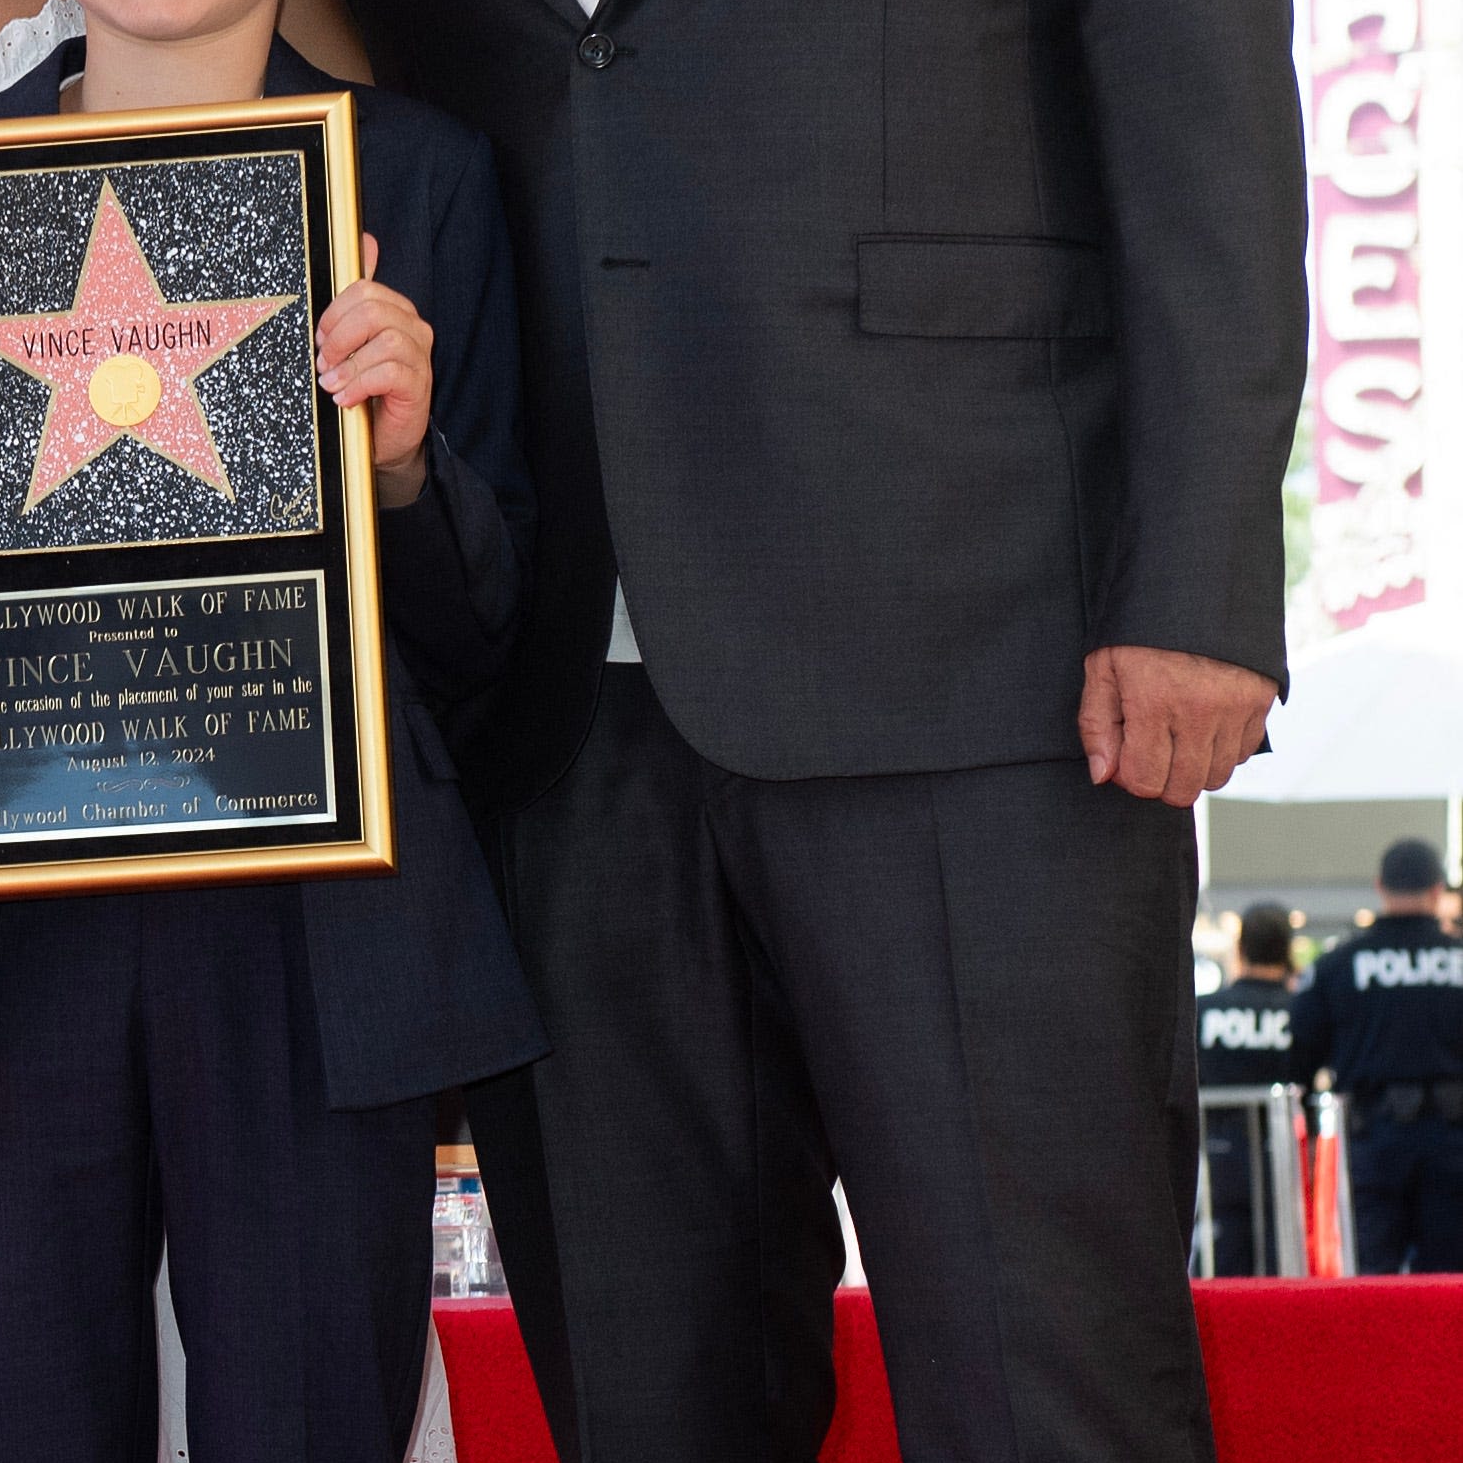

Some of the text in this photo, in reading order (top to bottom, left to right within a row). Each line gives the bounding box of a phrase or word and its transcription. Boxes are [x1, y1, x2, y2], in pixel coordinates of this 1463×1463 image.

[22, 319, 212, 359] VINCE VAUGHN
[117, 595, 185, 621] WALK
[200, 591, 228, 615] OF
[243, 586, 307, 612] FAME
[89, 626, 178, 643] Presented to
[122, 638, 294, 679] VAUGHN
[14, 695, 63, 713] occasion
[70, 691, 83, 709] of
[90, 690, 111, 707] the
[118, 687, 179, 711] placement
[186, 683, 198, 700] of
[206, 684, 234, 703] your
[241, 682, 265, 697] star
[273, 678, 285, 695] in
[292, 676, 313, 693] the
[121, 715, 189, 742] WALK
[204, 712, 232, 736] OF
[247, 707, 311, 733] FAME
[67, 754, 128, 773] August
[171, 747, 216, 764] 2024
[82, 799, 168, 822] Chamber
[182, 796, 202, 815] of
[215, 792, 318, 812] Commerce
[1353, 947, 1463, 991] POLICE
